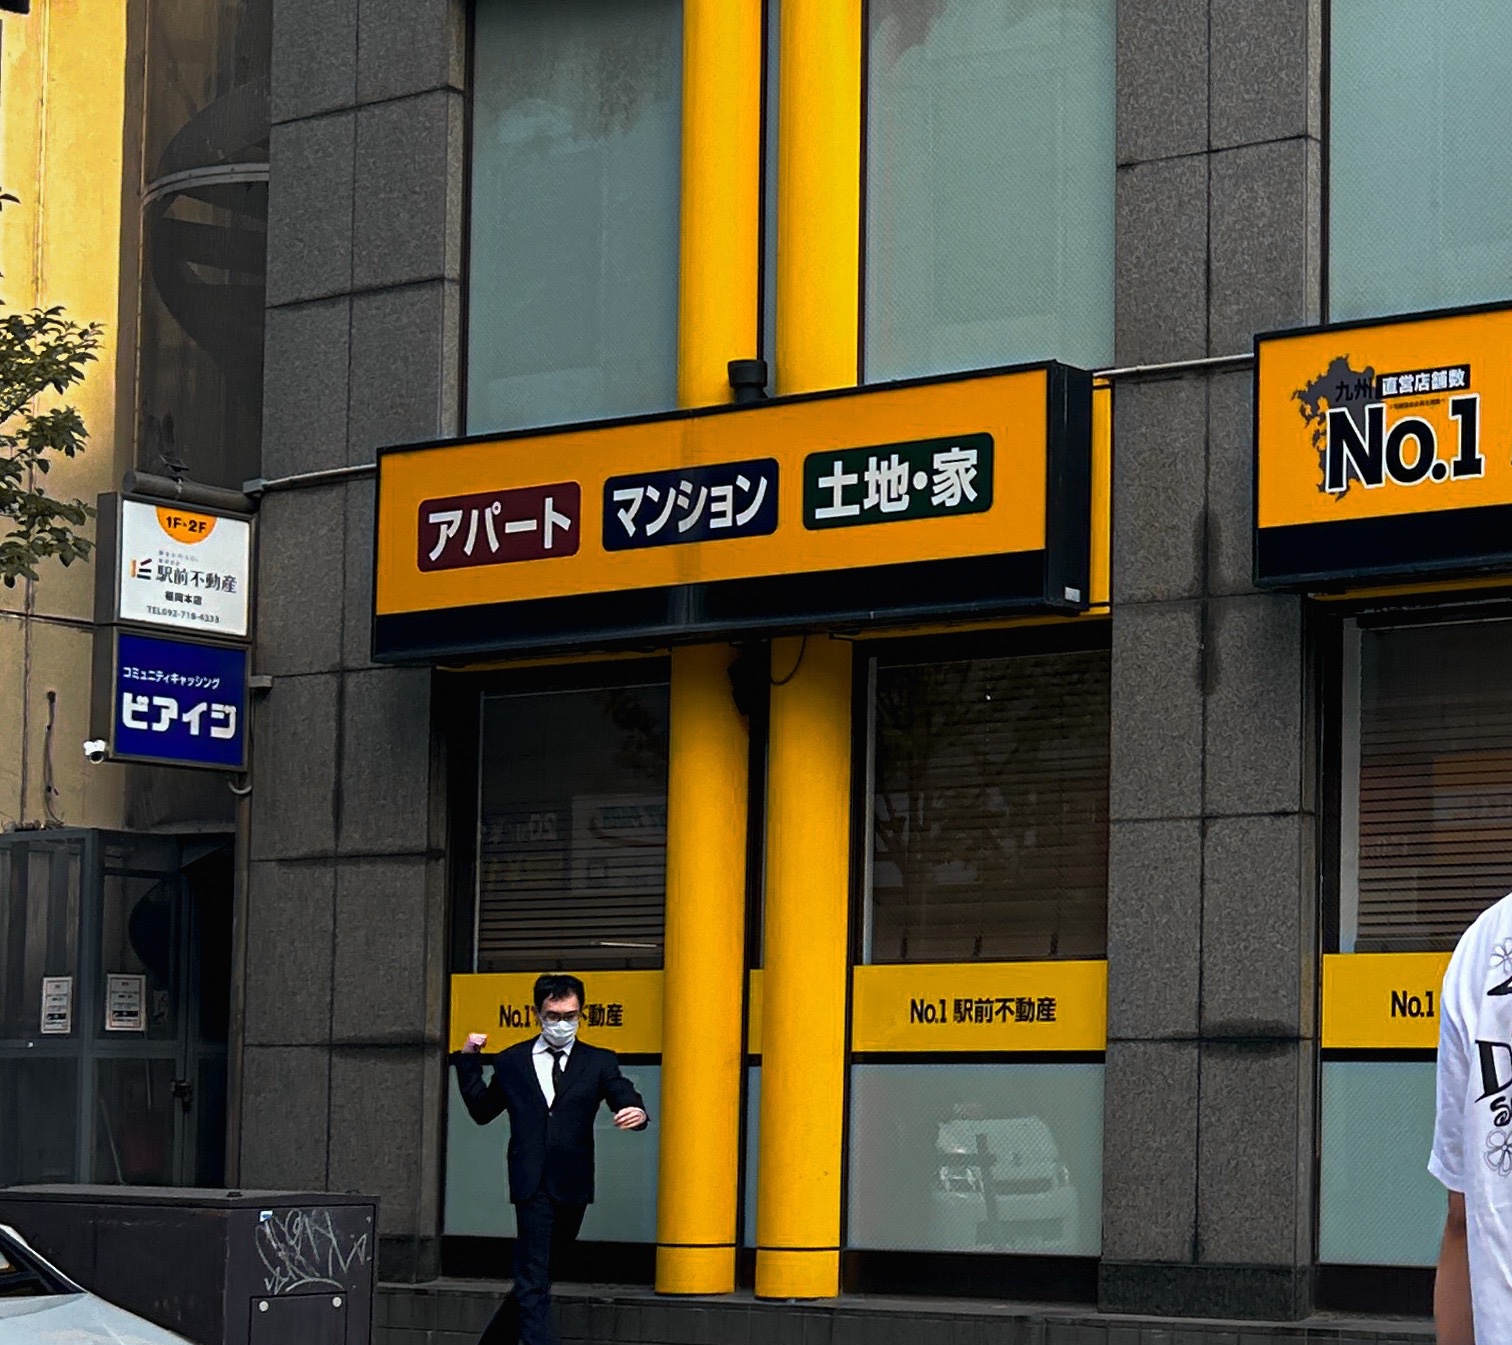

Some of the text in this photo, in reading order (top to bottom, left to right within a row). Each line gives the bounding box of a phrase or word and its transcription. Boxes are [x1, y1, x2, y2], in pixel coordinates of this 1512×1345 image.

[1327, 394, 1484, 492] No.1
[612, 474, 768, 538] マンション
[813, 446, 980, 522] 土地・家
[427, 496, 573, 562] アパート
[156, 564, 238, 594] 駅前不動産
[122, 666, 220, 690] コミュニティキャッシング
[910, 996, 1057, 1024] No.1 駅前不動産
[1390, 989, 1435, 1018] No.1
